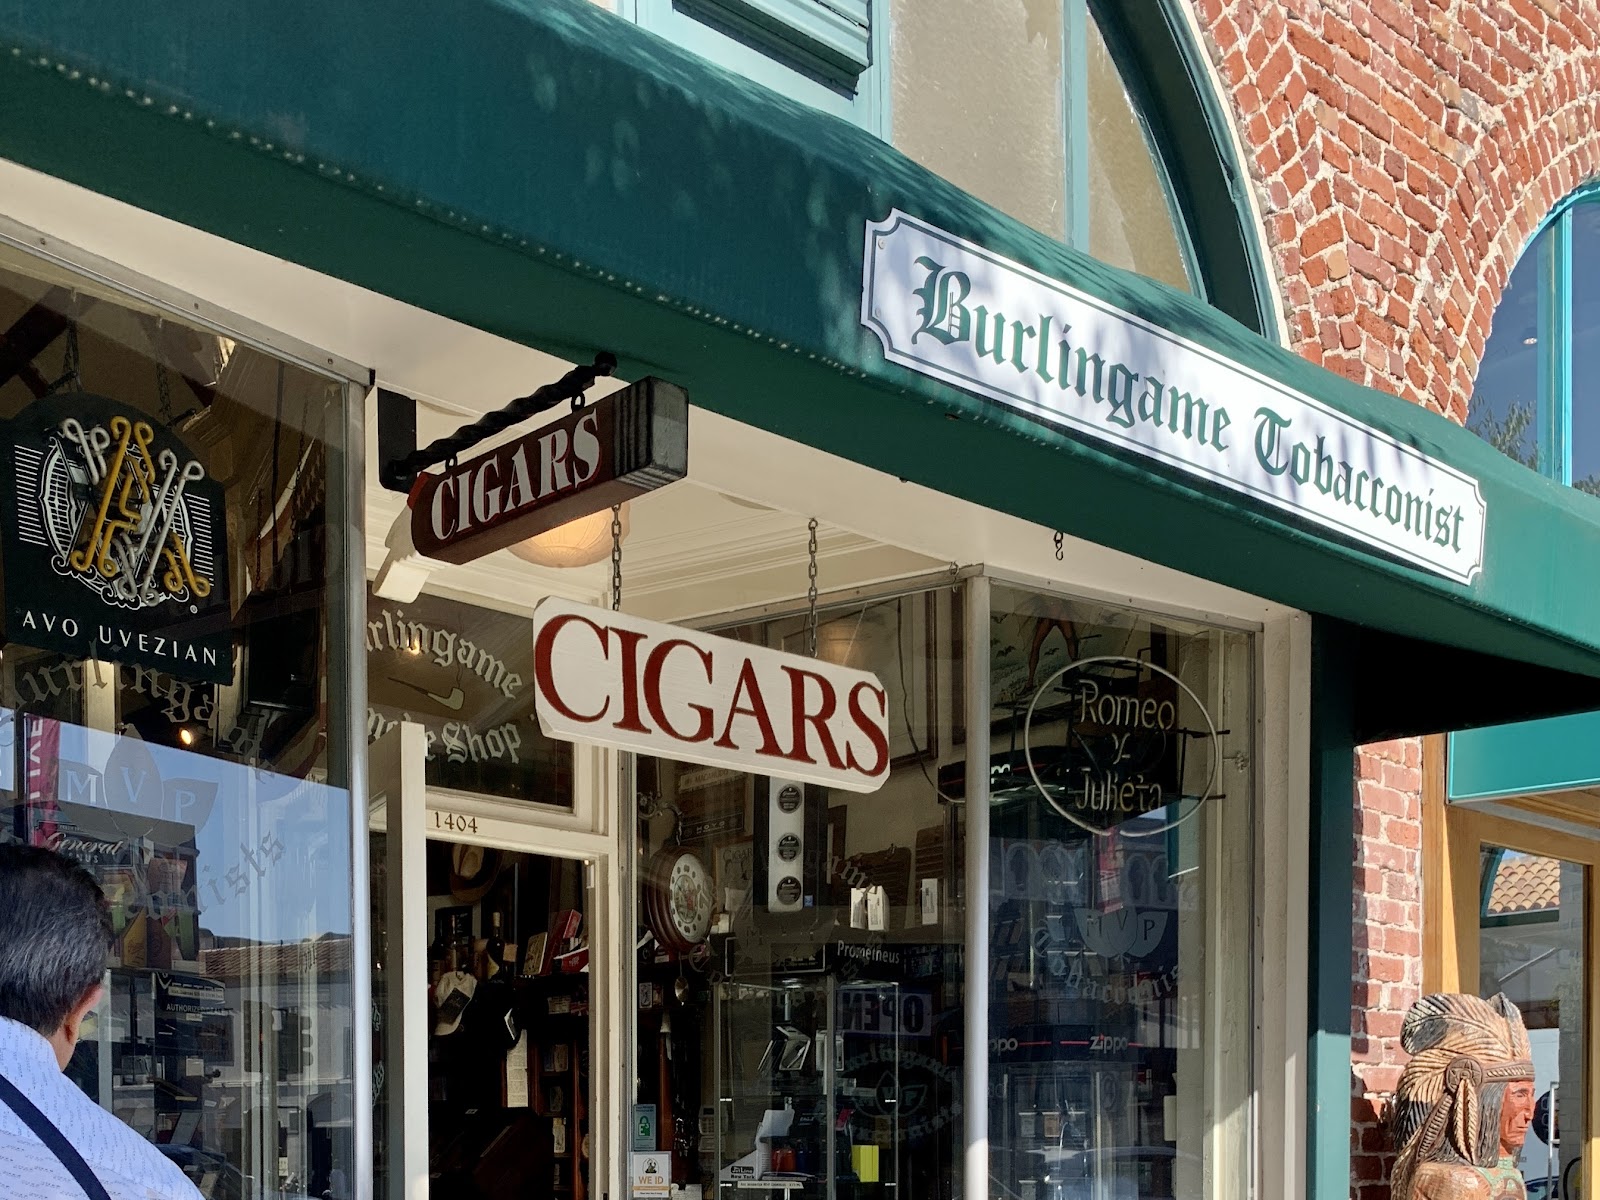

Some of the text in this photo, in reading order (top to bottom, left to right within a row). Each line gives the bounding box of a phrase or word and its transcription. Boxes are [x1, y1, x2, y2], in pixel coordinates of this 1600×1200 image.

[911, 255, 1466, 554] Burlingame Tobacconist
[431, 408, 600, 541] CIGARS
[22, 610, 217, 667] AVO UVEZIAN
[534, 613, 889, 778] CIGARS
[1077, 678, 1175, 732] Romeo
[441, 721, 522, 765] Shop
[1075, 766, 1163, 813] Julieta
[46, 832, 124, 856] General
[434, 811, 478, 834] 1404
[837, 940, 900, 965] Prometheus
[639, 1176, 664, 1185] WE ID
